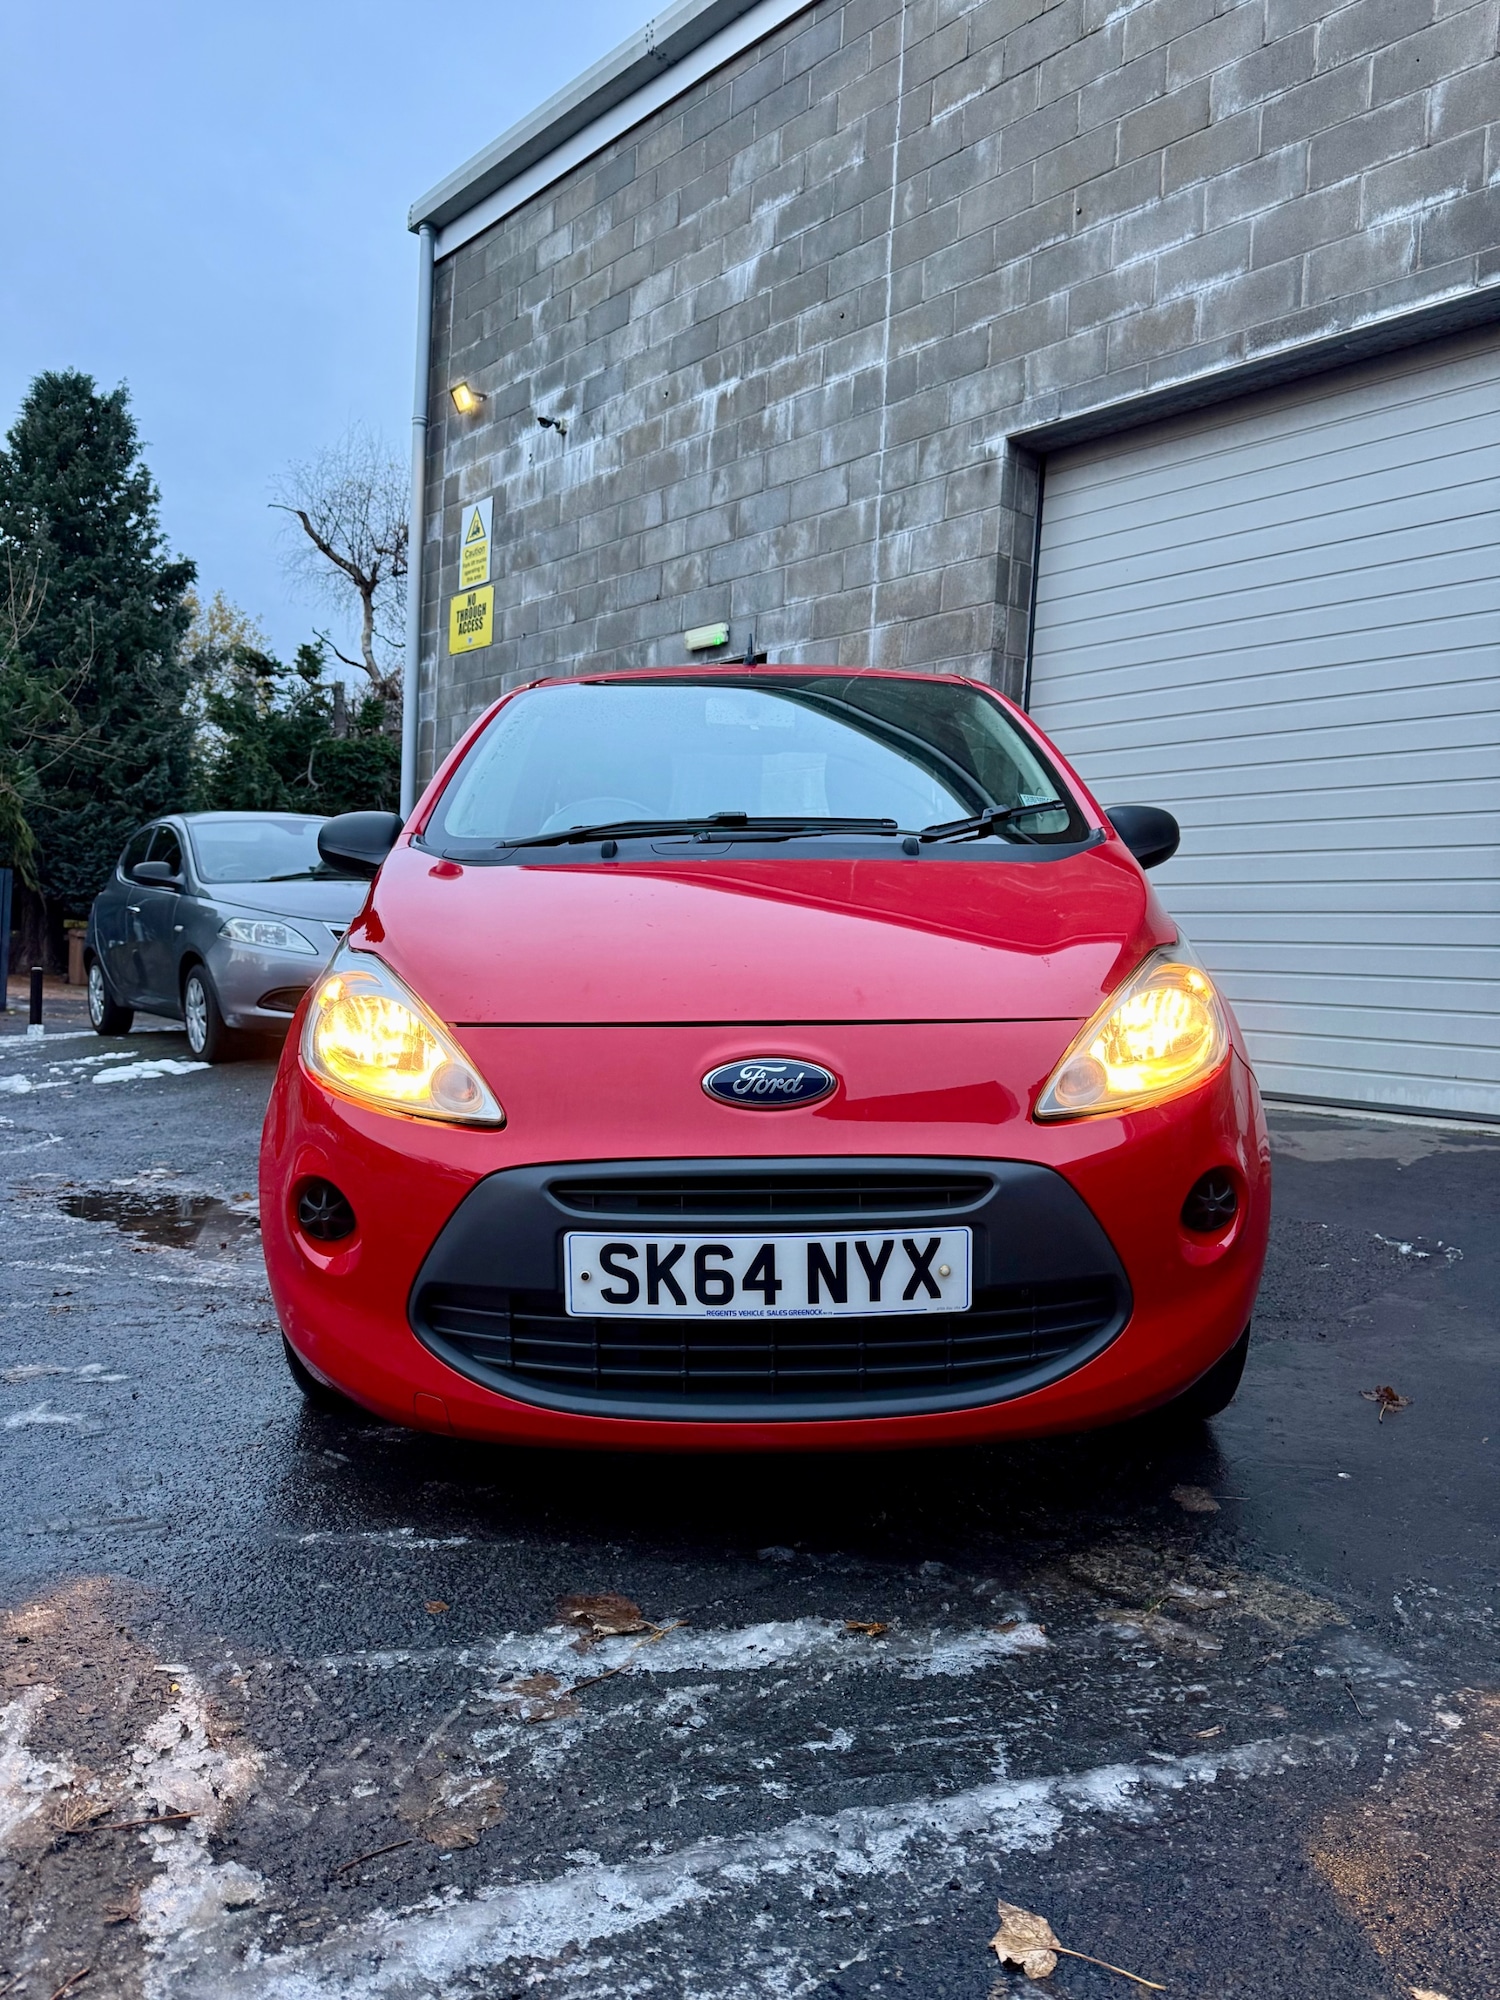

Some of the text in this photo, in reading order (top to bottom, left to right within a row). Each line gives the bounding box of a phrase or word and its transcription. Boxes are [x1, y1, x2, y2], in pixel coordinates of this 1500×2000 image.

[465, 545, 486, 559] Caution
[467, 592, 476, 607] NO
[456, 602, 487, 623] THROUGH
[458, 616, 483, 636] ACCESS
[733, 1065, 805, 1094] Ford
[600, 1237, 942, 1306] SK64 NYX
